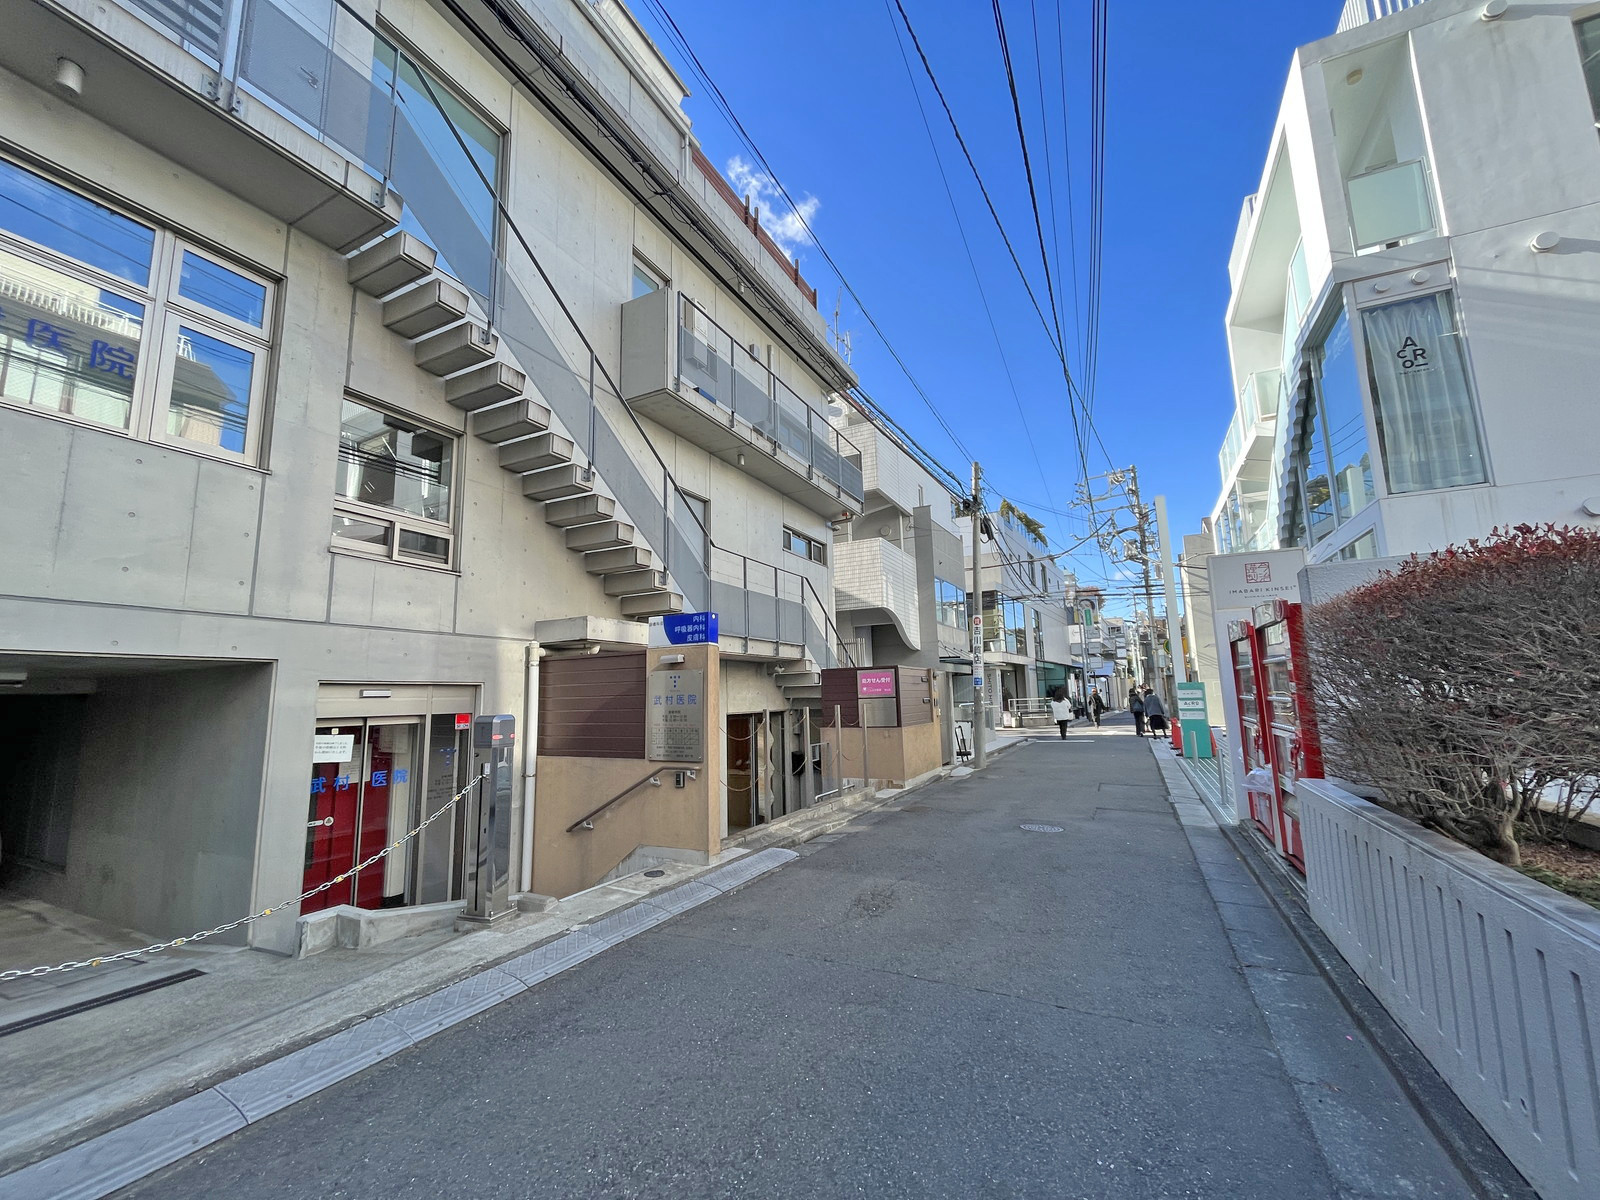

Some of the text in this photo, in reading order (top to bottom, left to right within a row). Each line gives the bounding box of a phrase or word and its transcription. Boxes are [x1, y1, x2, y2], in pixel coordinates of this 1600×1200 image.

[692, 614, 706, 623] 内科
[674, 624, 706, 633] 呼吸器内科
[686, 633, 706, 642] 皮膚科
[653, 694, 697, 705] 武村医院
